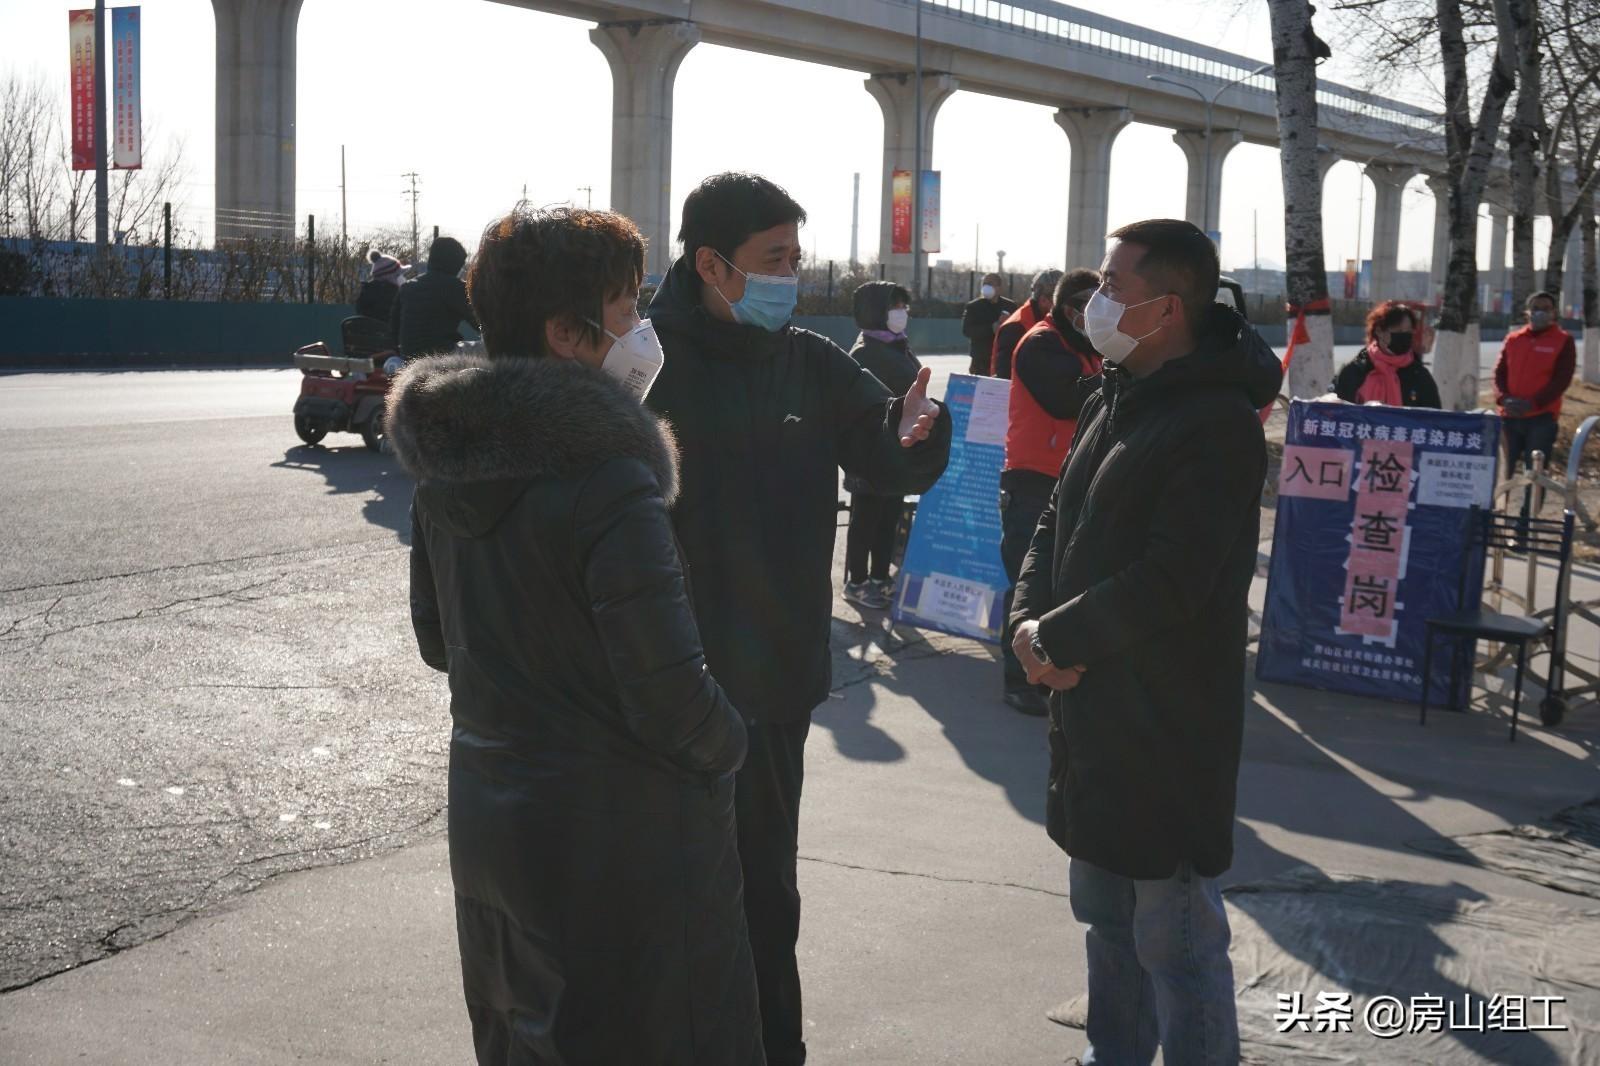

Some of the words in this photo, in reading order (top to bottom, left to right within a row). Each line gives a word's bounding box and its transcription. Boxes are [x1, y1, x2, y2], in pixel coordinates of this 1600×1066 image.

[1303, 419, 1481, 449] 新型冠状病毒感染肺炎
[1285, 455, 1344, 487] 入口
[1349, 452, 1406, 618] 检查岗
